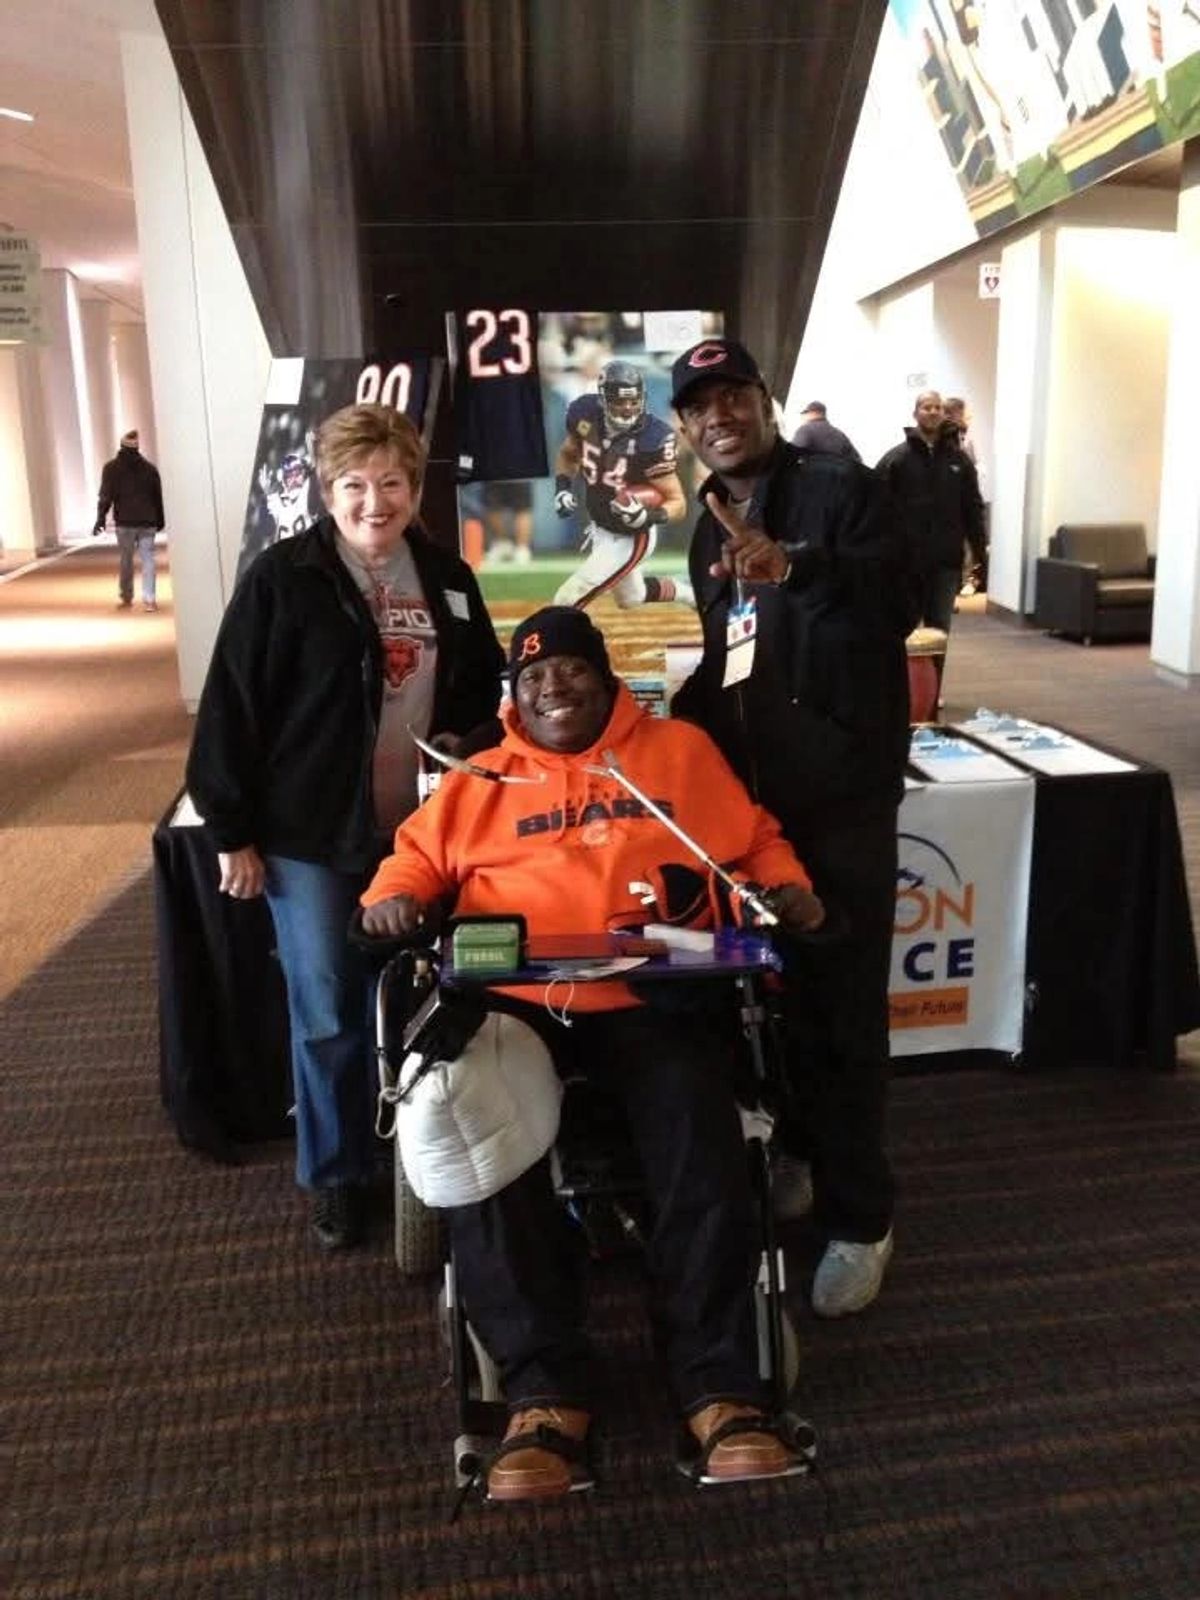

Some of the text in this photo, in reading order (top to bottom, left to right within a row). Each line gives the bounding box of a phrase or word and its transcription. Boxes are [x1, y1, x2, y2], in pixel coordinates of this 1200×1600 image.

[466, 308, 532, 378] 23
[687, 343, 728, 368] C
[582, 441, 628, 493] 54
[517, 632, 541, 661] B
[903, 938, 975, 982] CE
